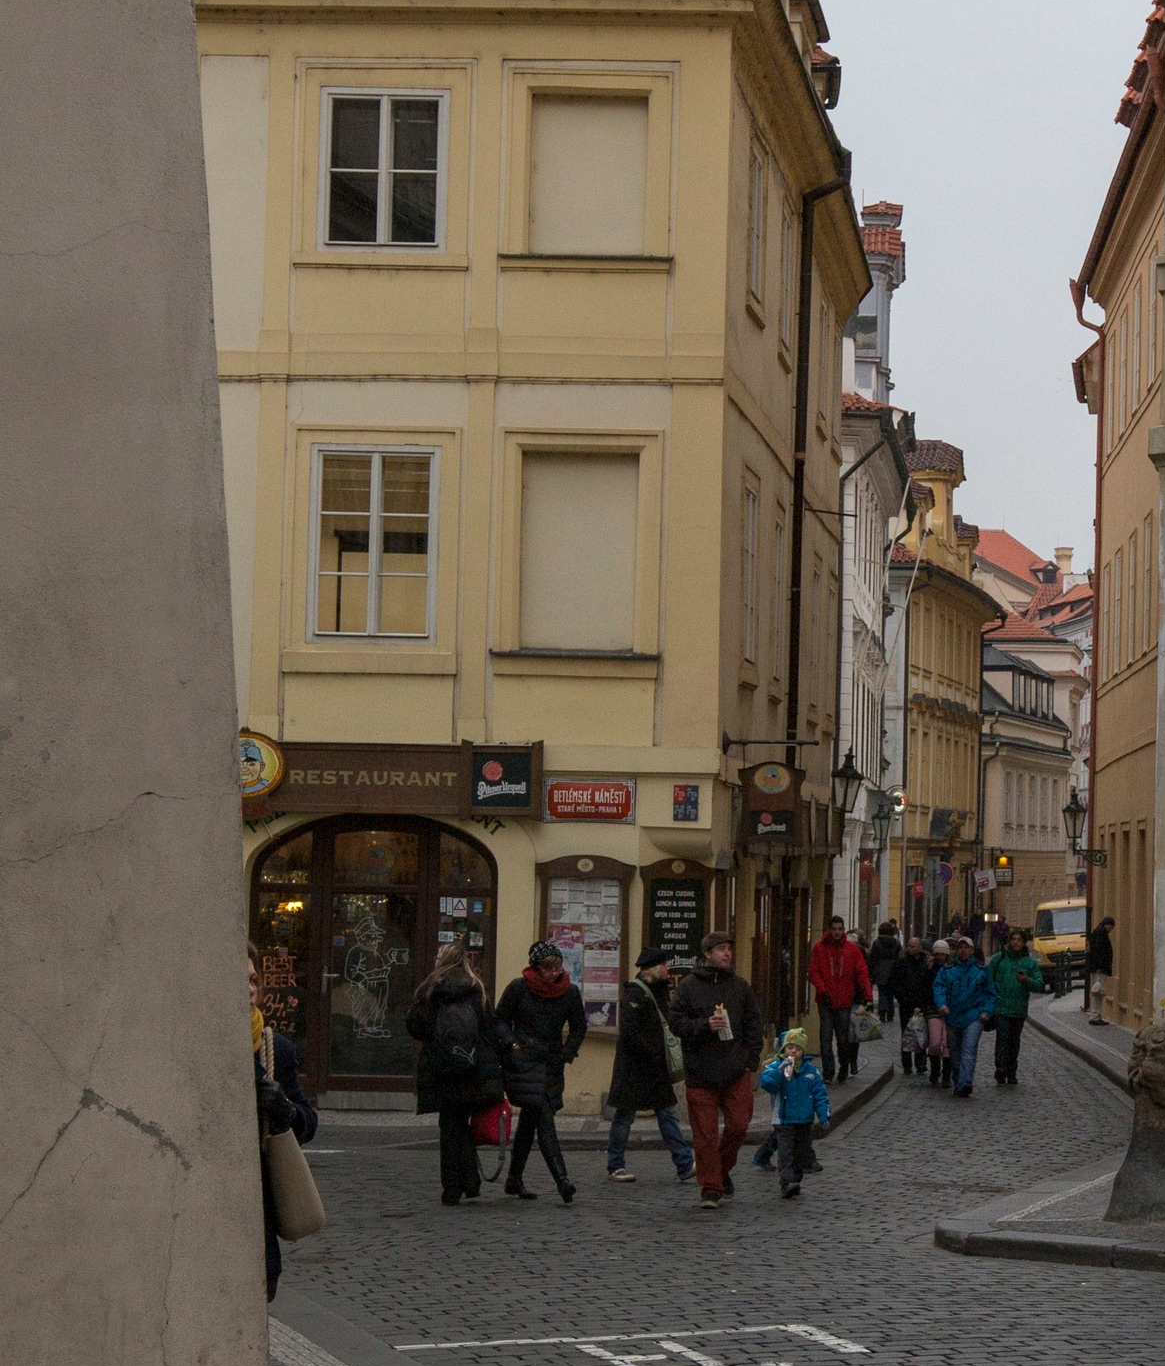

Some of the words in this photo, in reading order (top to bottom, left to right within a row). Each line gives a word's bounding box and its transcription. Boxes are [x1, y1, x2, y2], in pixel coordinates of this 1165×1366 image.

[289, 769, 458, 787] RESTAURANT
[553, 787, 592, 803] BETLÉMSKÉ
[594, 788, 627, 804] NÁMĚSTÍ
[557, 803, 576, 813] STARÉ
[262, 954, 297, 972] BEST
[263, 972, 297, 988] BEER
